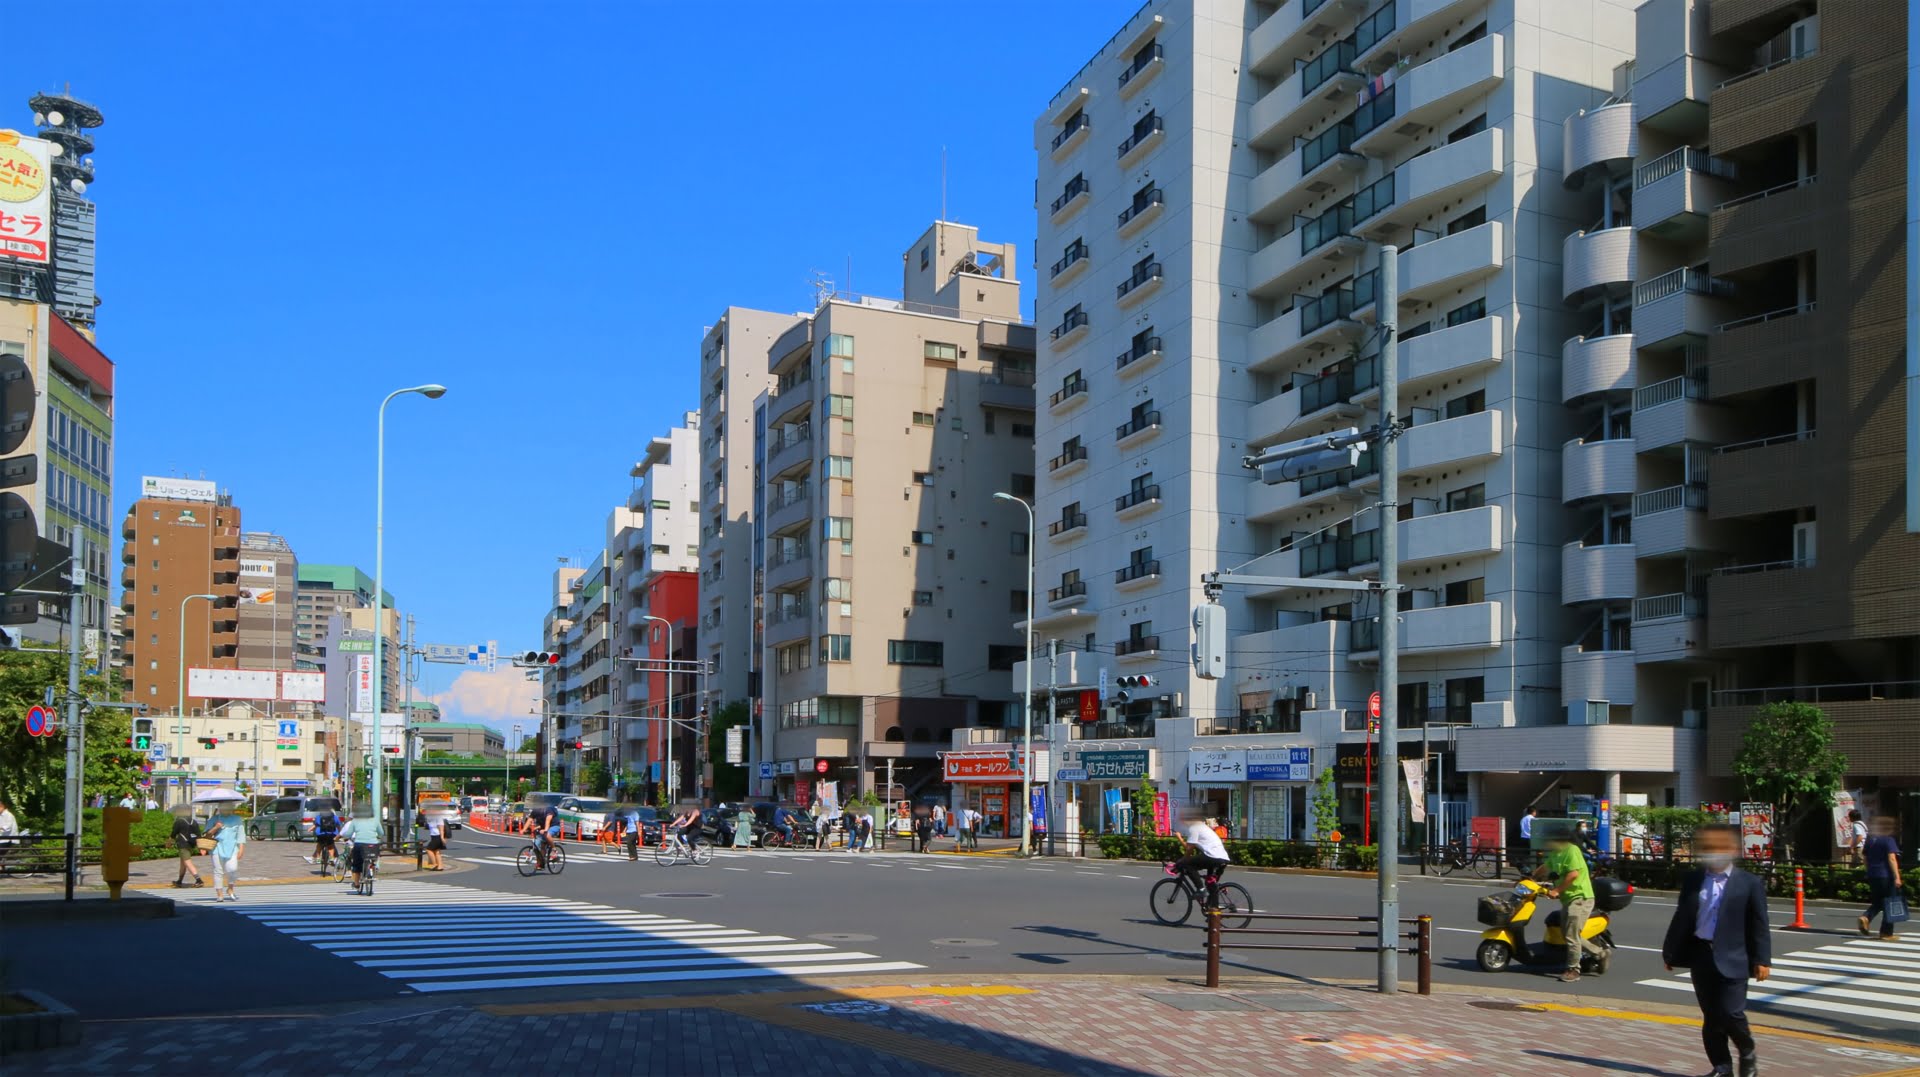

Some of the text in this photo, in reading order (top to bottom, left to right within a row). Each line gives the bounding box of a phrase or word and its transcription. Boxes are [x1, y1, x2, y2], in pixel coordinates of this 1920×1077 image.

[0, 157, 38, 179] 人気!
[338, 641, 362, 651] ACE INN
[975, 762, 1009, 773] オールワン
[1340, 756, 1379, 767] CENU
[1086, 762, 1145, 776] 処方せん受付
[1194, 762, 1242, 775] ドラゴーネ
